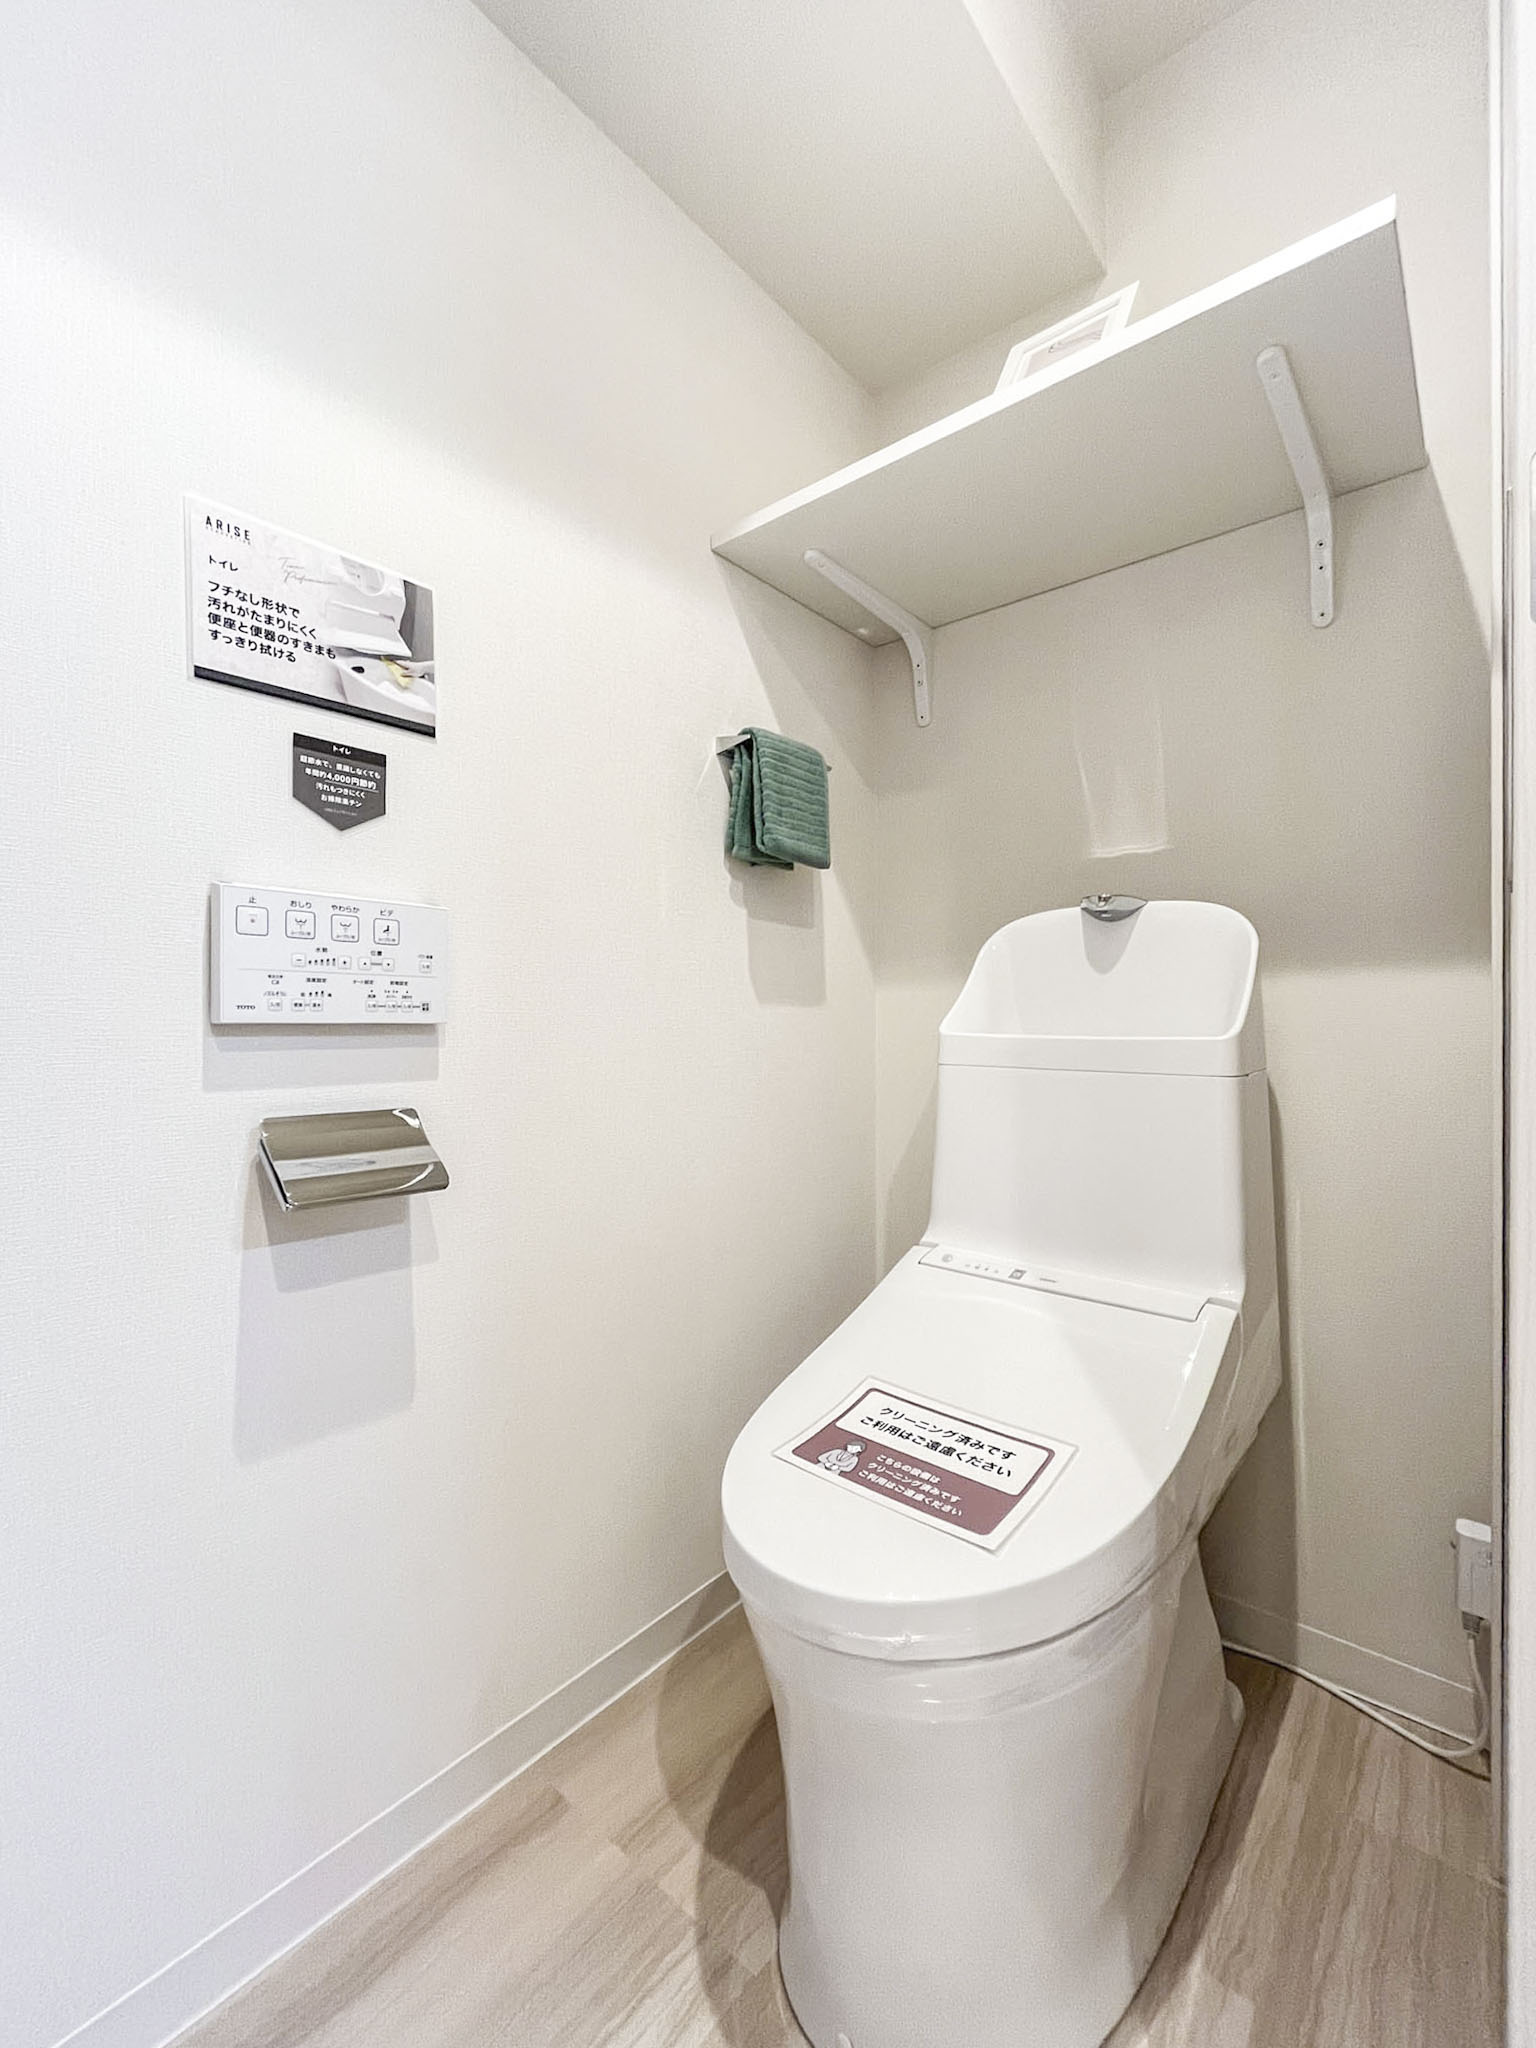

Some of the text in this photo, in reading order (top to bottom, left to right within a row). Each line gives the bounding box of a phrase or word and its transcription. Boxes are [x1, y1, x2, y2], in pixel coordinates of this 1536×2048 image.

[205, 515, 251, 540] ARISE
[208, 555, 239, 571] トイレ
[208, 580, 300, 618] フチなし形状で
[208, 596, 317, 640] 汚れがたまりにくく
[207, 612, 336, 659] 便座と便器のすきまも
[208, 629, 297, 663] すっきり拭ける
[333, 745, 351, 755] トイレ
[290, 900, 312, 909] おしり
[331, 904, 360, 914] やわらか
[860, 1416, 1011, 1478] ご利用はご遠慮ください
[879, 1407, 1017, 1460] クリーニング済みです
[858, 1469, 962, 1516] ご利用はご遠慮ください
[867, 1462, 961, 1503] クリーニング済みです
